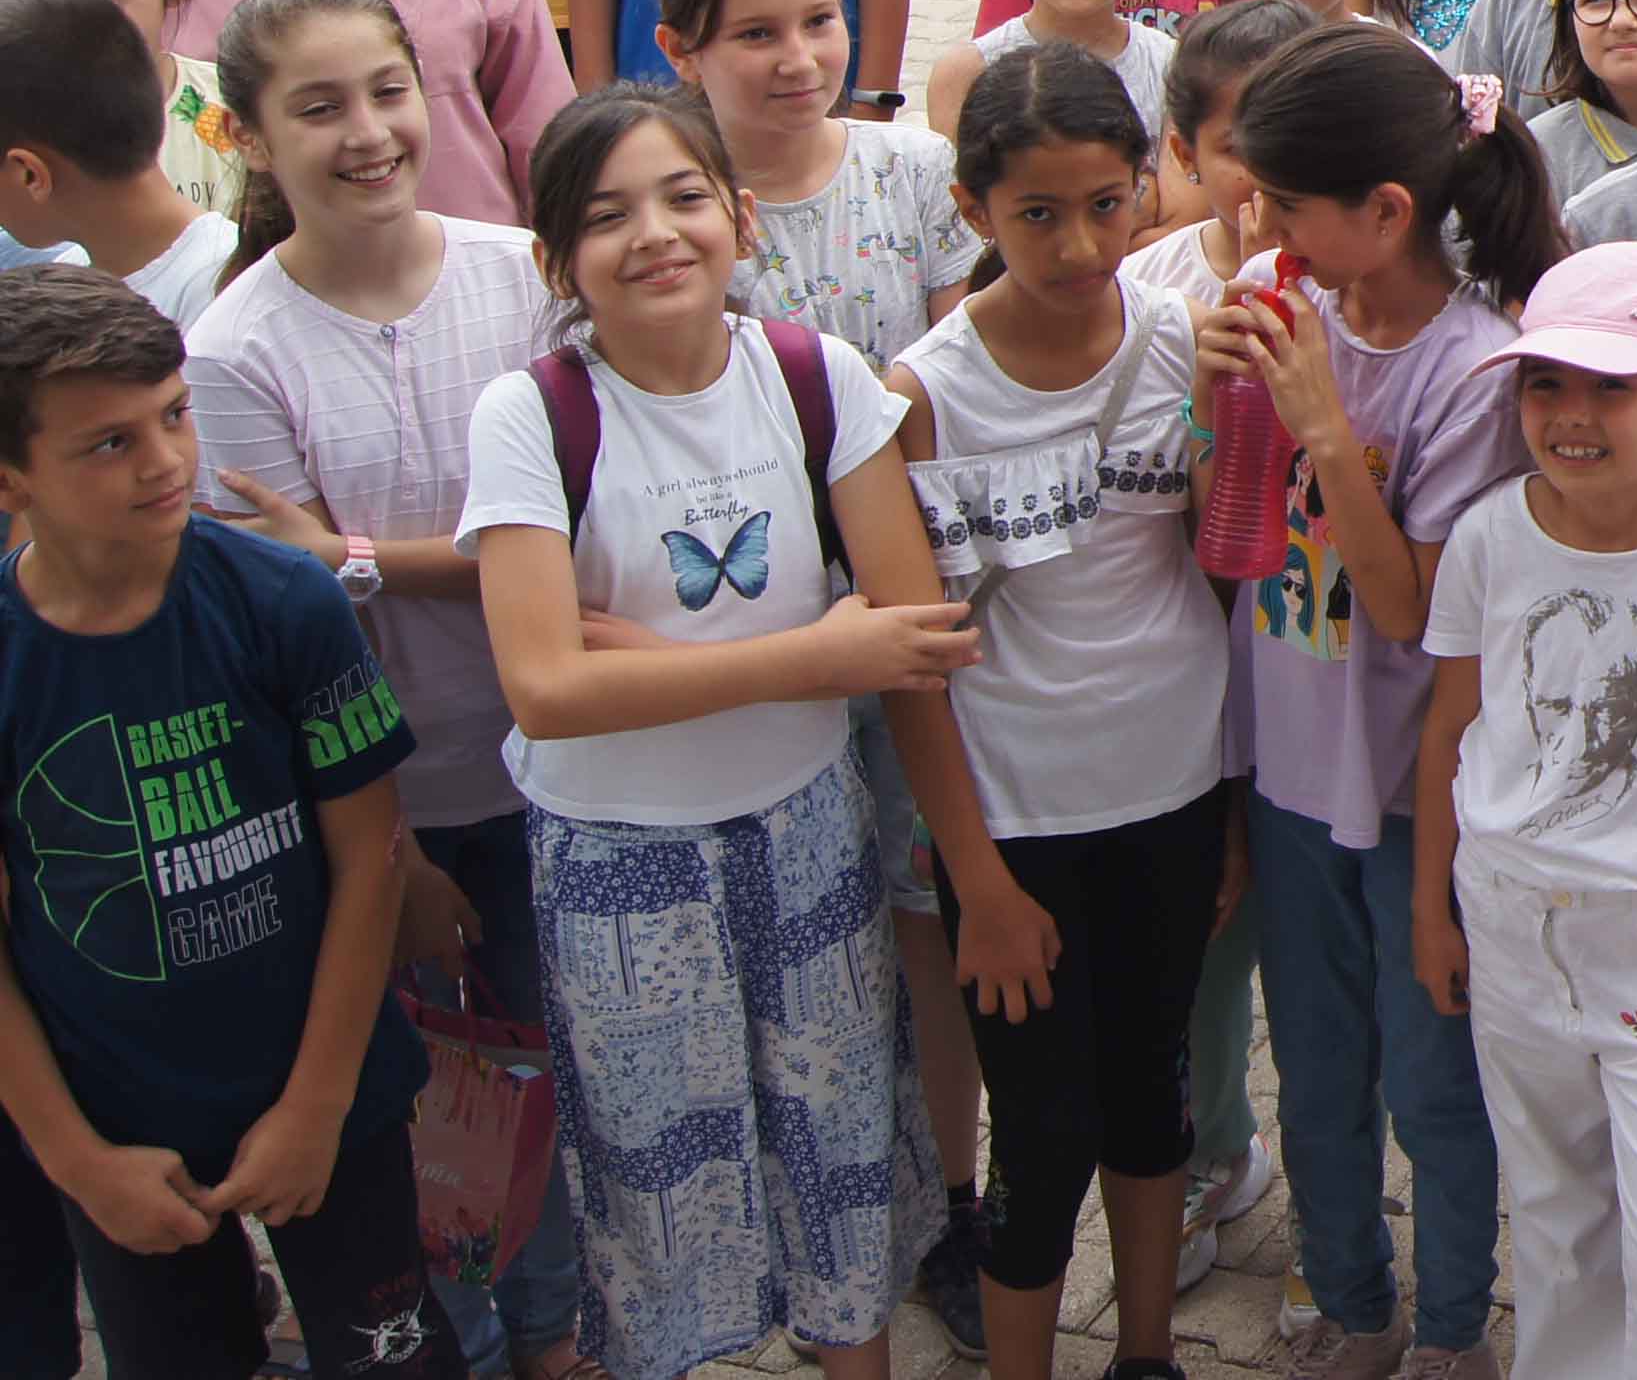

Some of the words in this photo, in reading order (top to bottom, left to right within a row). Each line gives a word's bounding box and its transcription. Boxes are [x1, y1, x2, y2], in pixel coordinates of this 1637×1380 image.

[642, 484, 654, 496] A
[655, 478, 682, 498] girl
[686, 473, 732, 490] always
[732, 458, 779, 480] should
[683, 499, 750, 526] Butterfly
[139, 757, 240, 842] BALL
[167, 874, 282, 966] GAME
